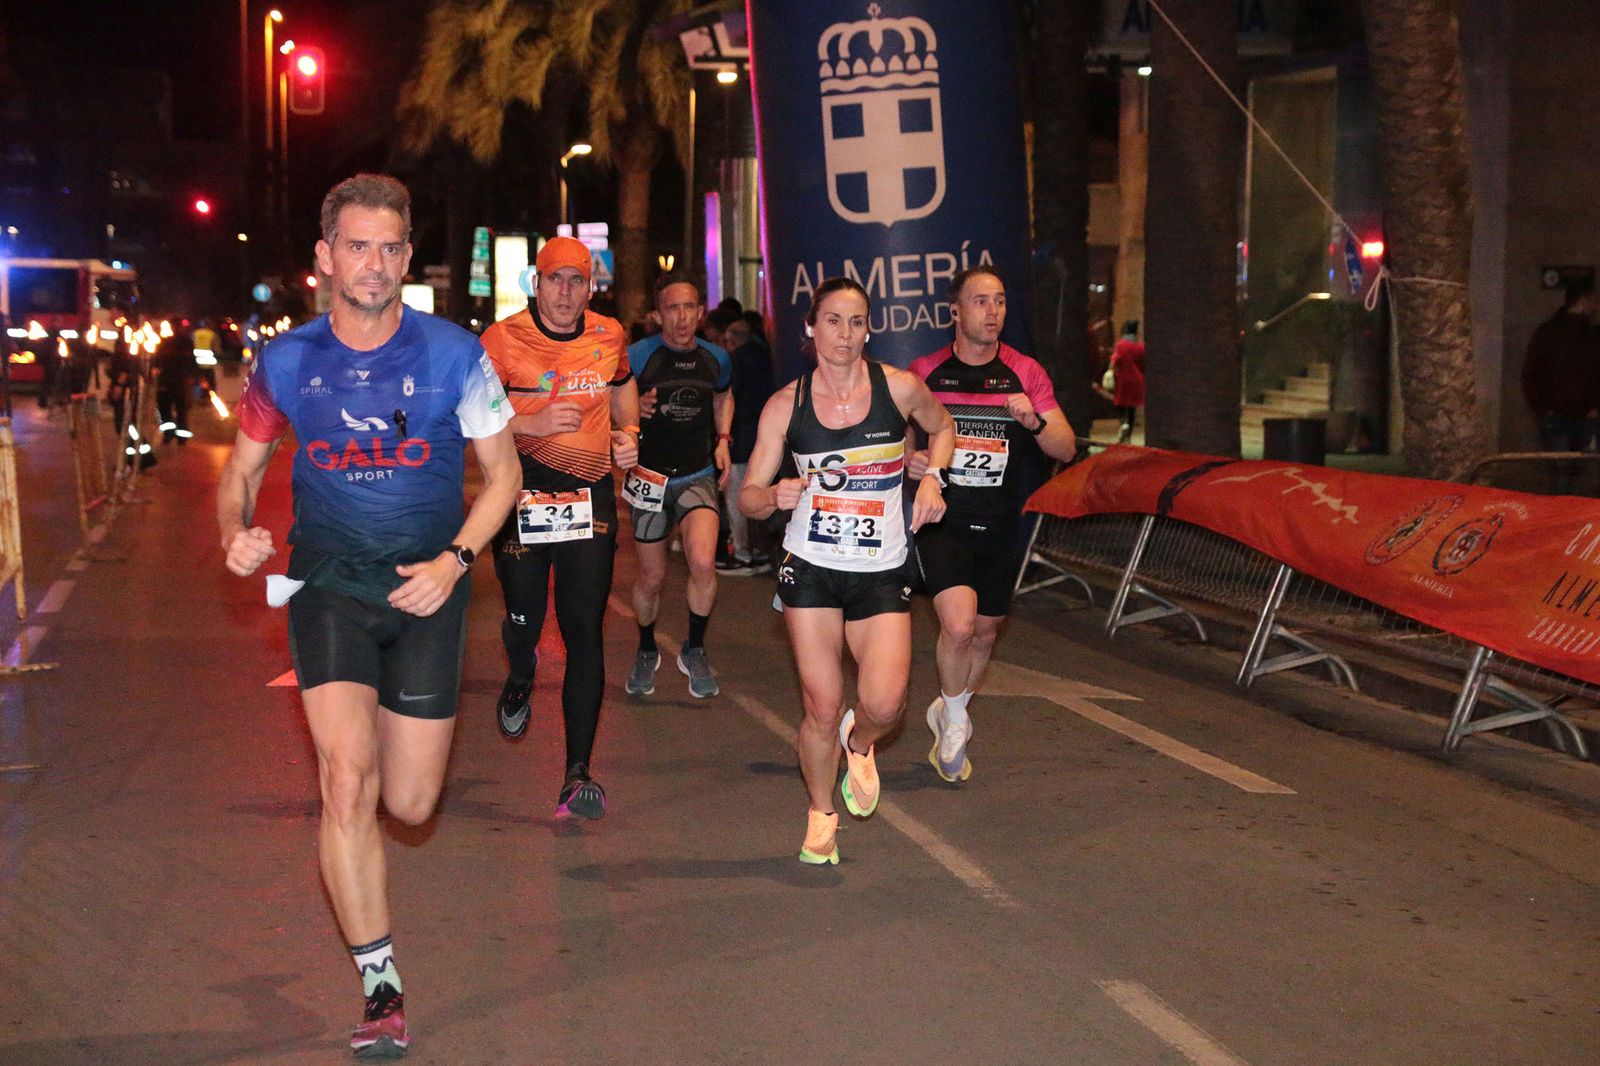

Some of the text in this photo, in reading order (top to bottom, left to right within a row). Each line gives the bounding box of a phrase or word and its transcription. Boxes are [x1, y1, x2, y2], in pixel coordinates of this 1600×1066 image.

[868, 302, 955, 335] UDAD
[300, 386, 333, 395] SPIRAL
[959, 421, 1007, 431] TIERRAS DE
[306, 437, 432, 470] GALO
[963, 452, 992, 471] 22
[346, 469, 394, 482] SPORT
[633, 478, 652, 497] 28
[851, 481, 878, 490] SPORT
[544, 504, 575, 524] 34
[826, 514, 876, 538] 323
[1542, 570, 1600, 621] ALME
